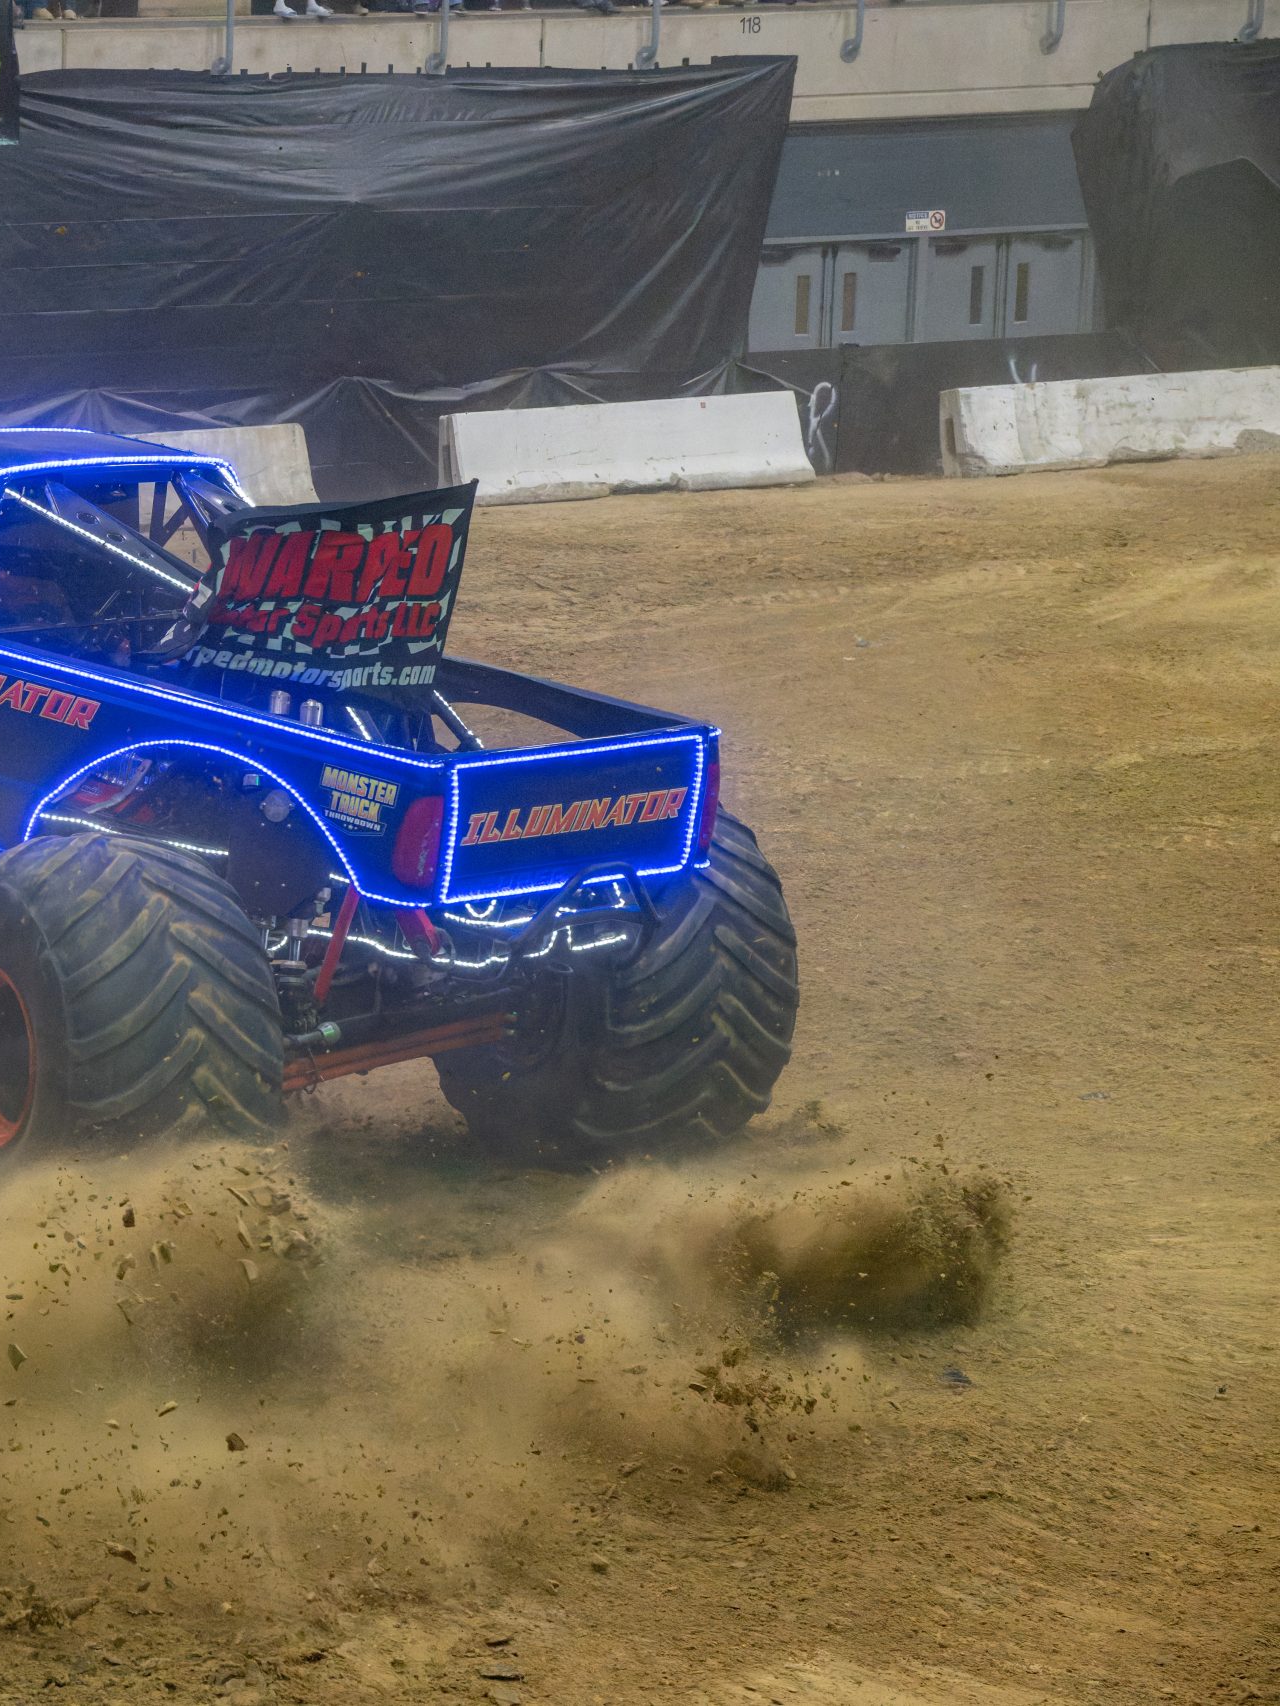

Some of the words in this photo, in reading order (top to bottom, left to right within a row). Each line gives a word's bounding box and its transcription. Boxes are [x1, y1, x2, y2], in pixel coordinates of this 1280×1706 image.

[740, 16, 761, 34] 118
[218, 522, 454, 604] WARPED
[290, 602, 391, 648] Sports
[391, 601, 443, 638] LLC
[321, 766, 398, 806] MONSTER
[330, 789, 381, 823] TRUCK
[323, 809, 382, 832] THROWDOWN
[460, 787, 689, 847] ILLUMINATOR
